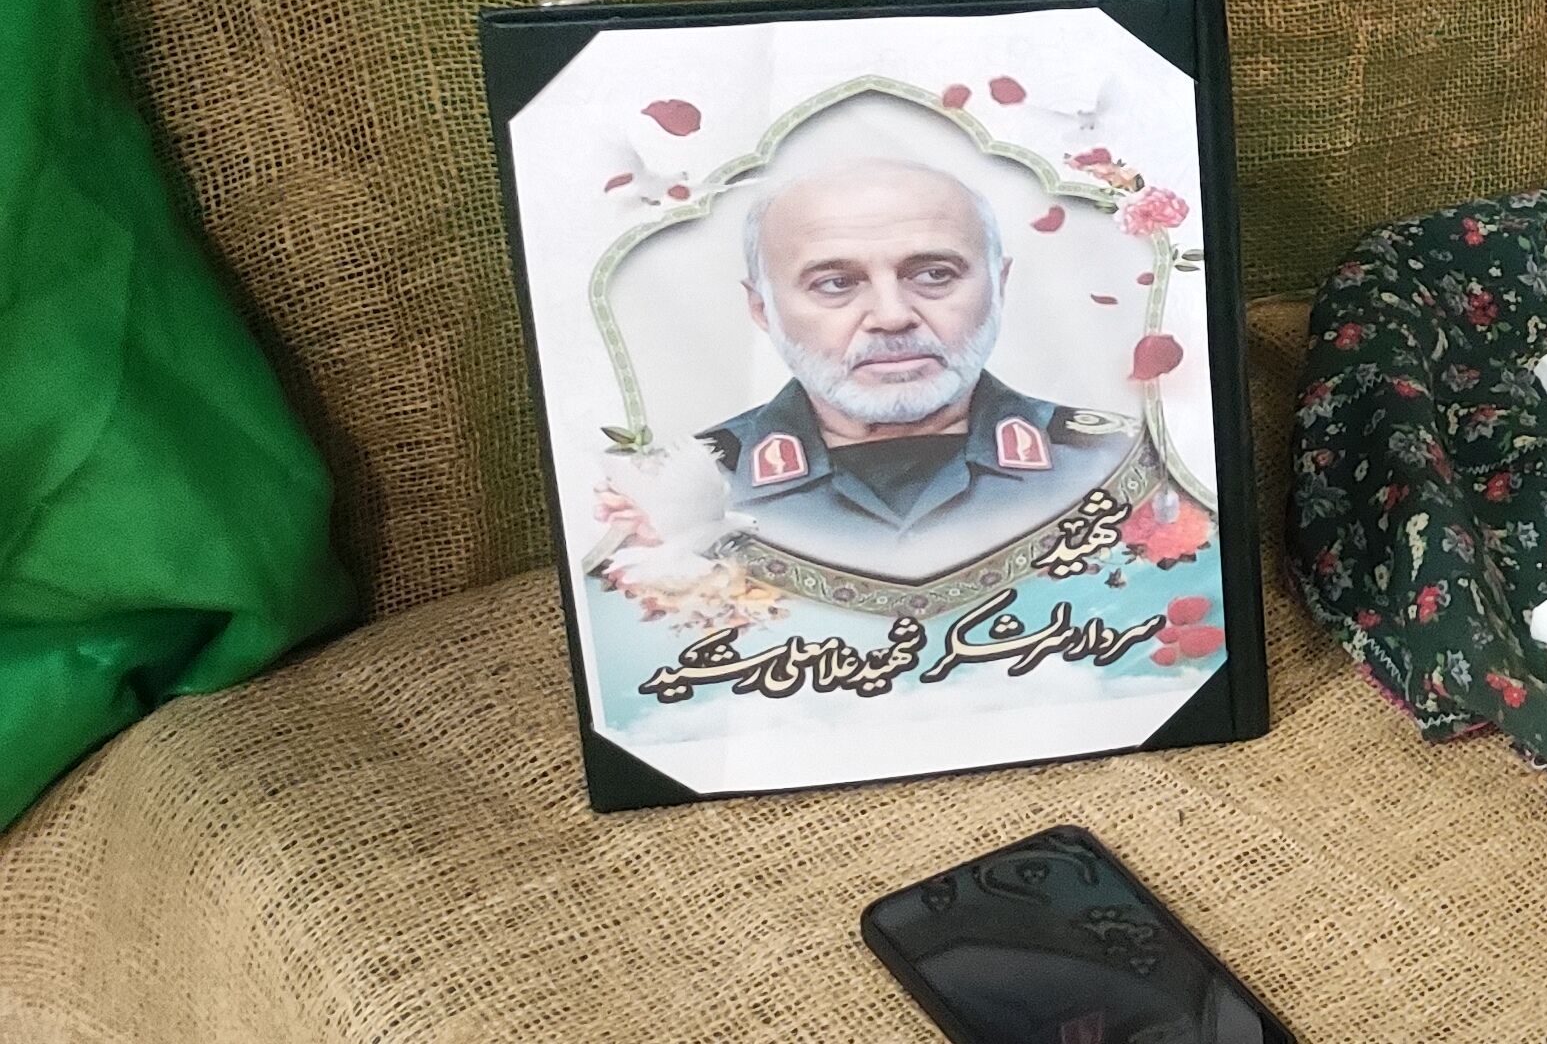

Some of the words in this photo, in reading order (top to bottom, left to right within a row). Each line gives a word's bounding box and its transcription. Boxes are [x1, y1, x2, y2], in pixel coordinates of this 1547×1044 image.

[1032, 488, 1132, 579] شهید
[757, 636, 858, 698] غلامعلی
[848, 617, 926, 698] شهید
[922, 589, 1072, 683] سرلشکر
[1064, 612, 1167, 666] سردار
